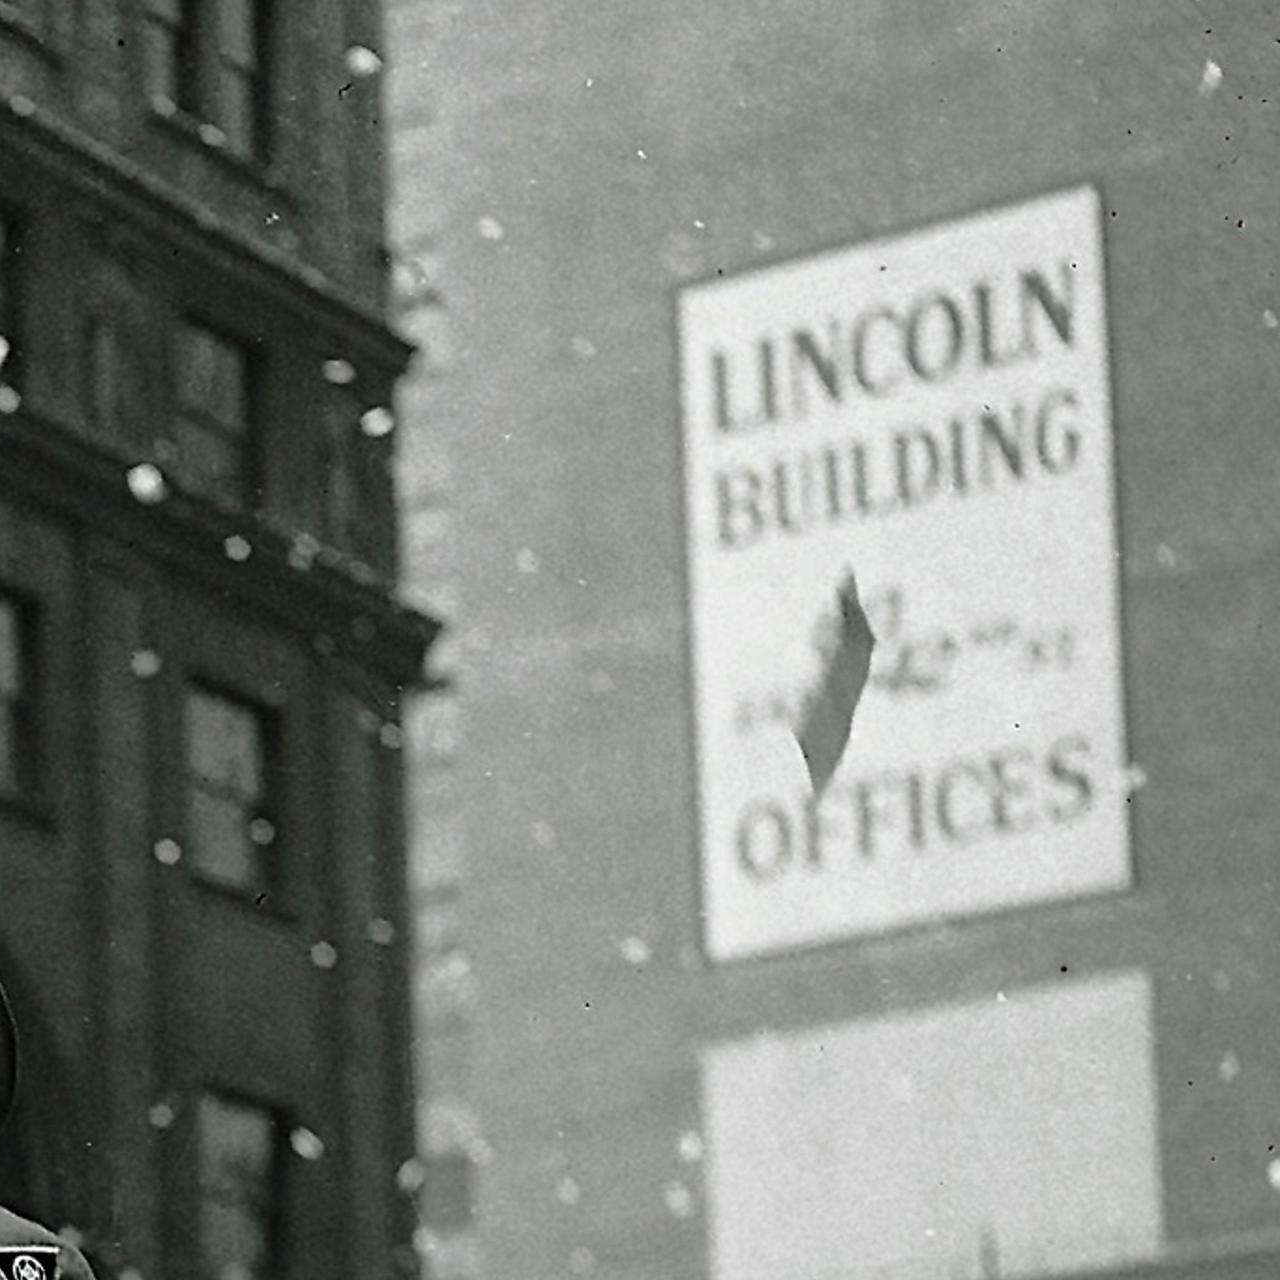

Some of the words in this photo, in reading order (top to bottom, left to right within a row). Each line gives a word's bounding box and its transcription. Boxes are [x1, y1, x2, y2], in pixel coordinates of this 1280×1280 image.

[711, 260, 1077, 434] LINCOLN
[715, 388, 1082, 550] BUILDING
[736, 733, 1093, 884] OFFICES
